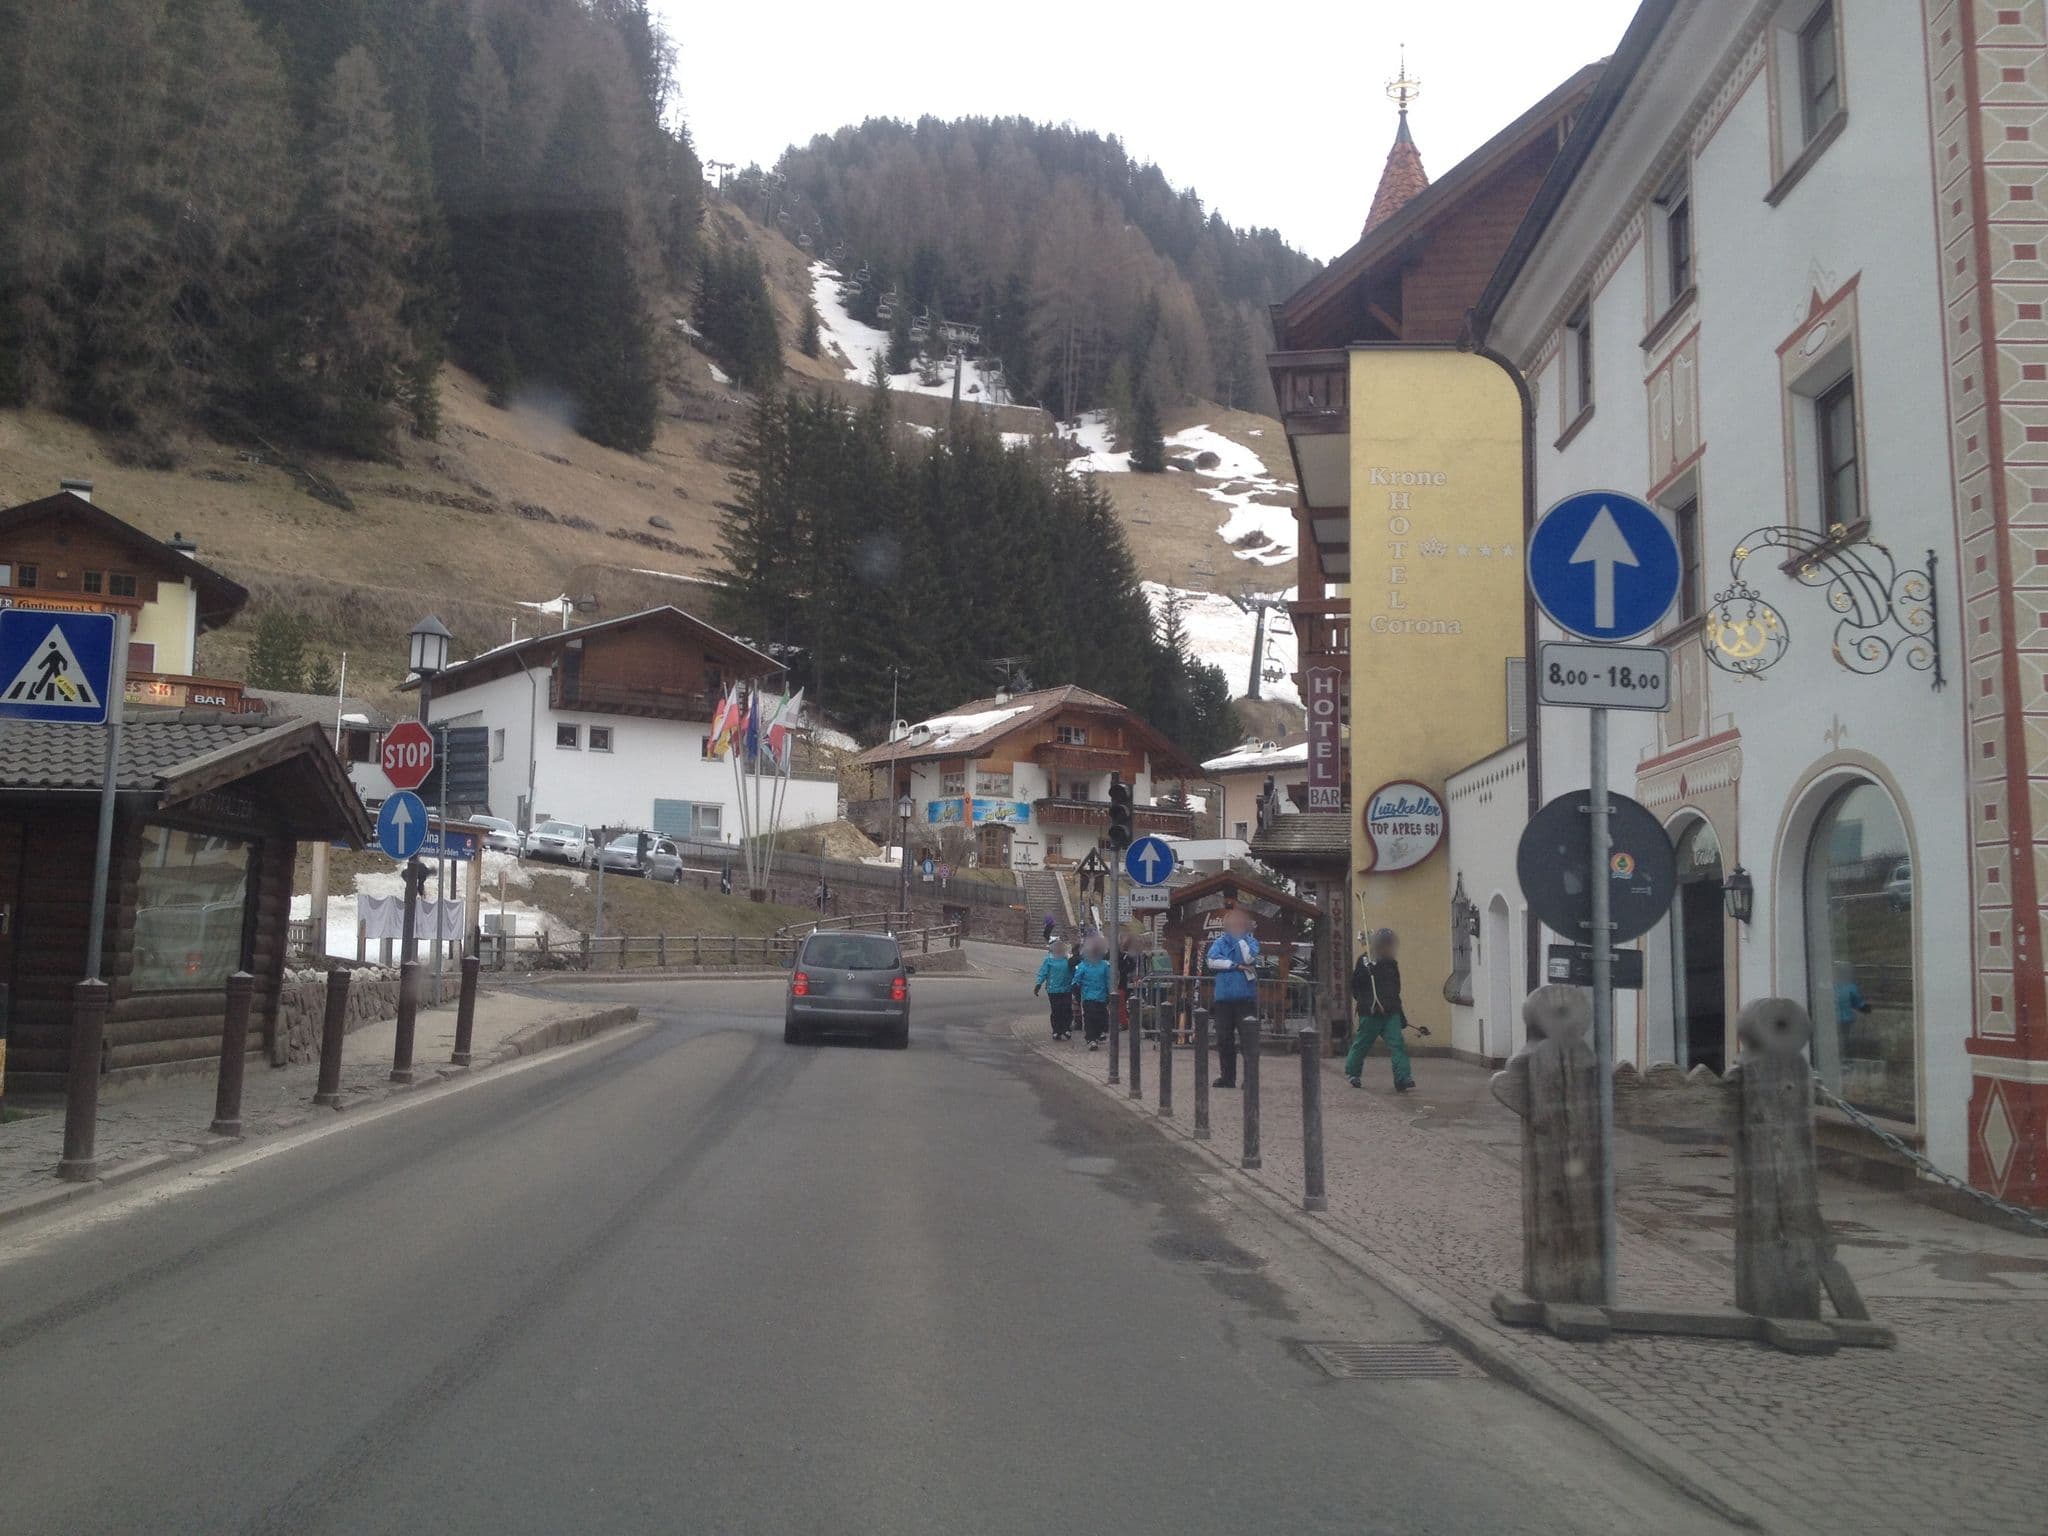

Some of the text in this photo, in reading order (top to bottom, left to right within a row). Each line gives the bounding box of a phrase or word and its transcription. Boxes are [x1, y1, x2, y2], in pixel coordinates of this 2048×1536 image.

[1368, 467, 1447, 486] Krone
[1388, 491, 1412, 610] HOTEL
[1369, 615, 1463, 635] Corona
[1549, 662, 1587, 686] 8,00
[1607, 665, 1660, 690] 18,00
[194, 694, 226, 706] BAR
[1313, 677, 1335, 779] HOTEL
[385, 741, 430, 769] STOP
[1310, 788, 1340, 806] BAR
[1370, 822, 1390, 835] TOP
[1392, 822, 1422, 836] APRES
